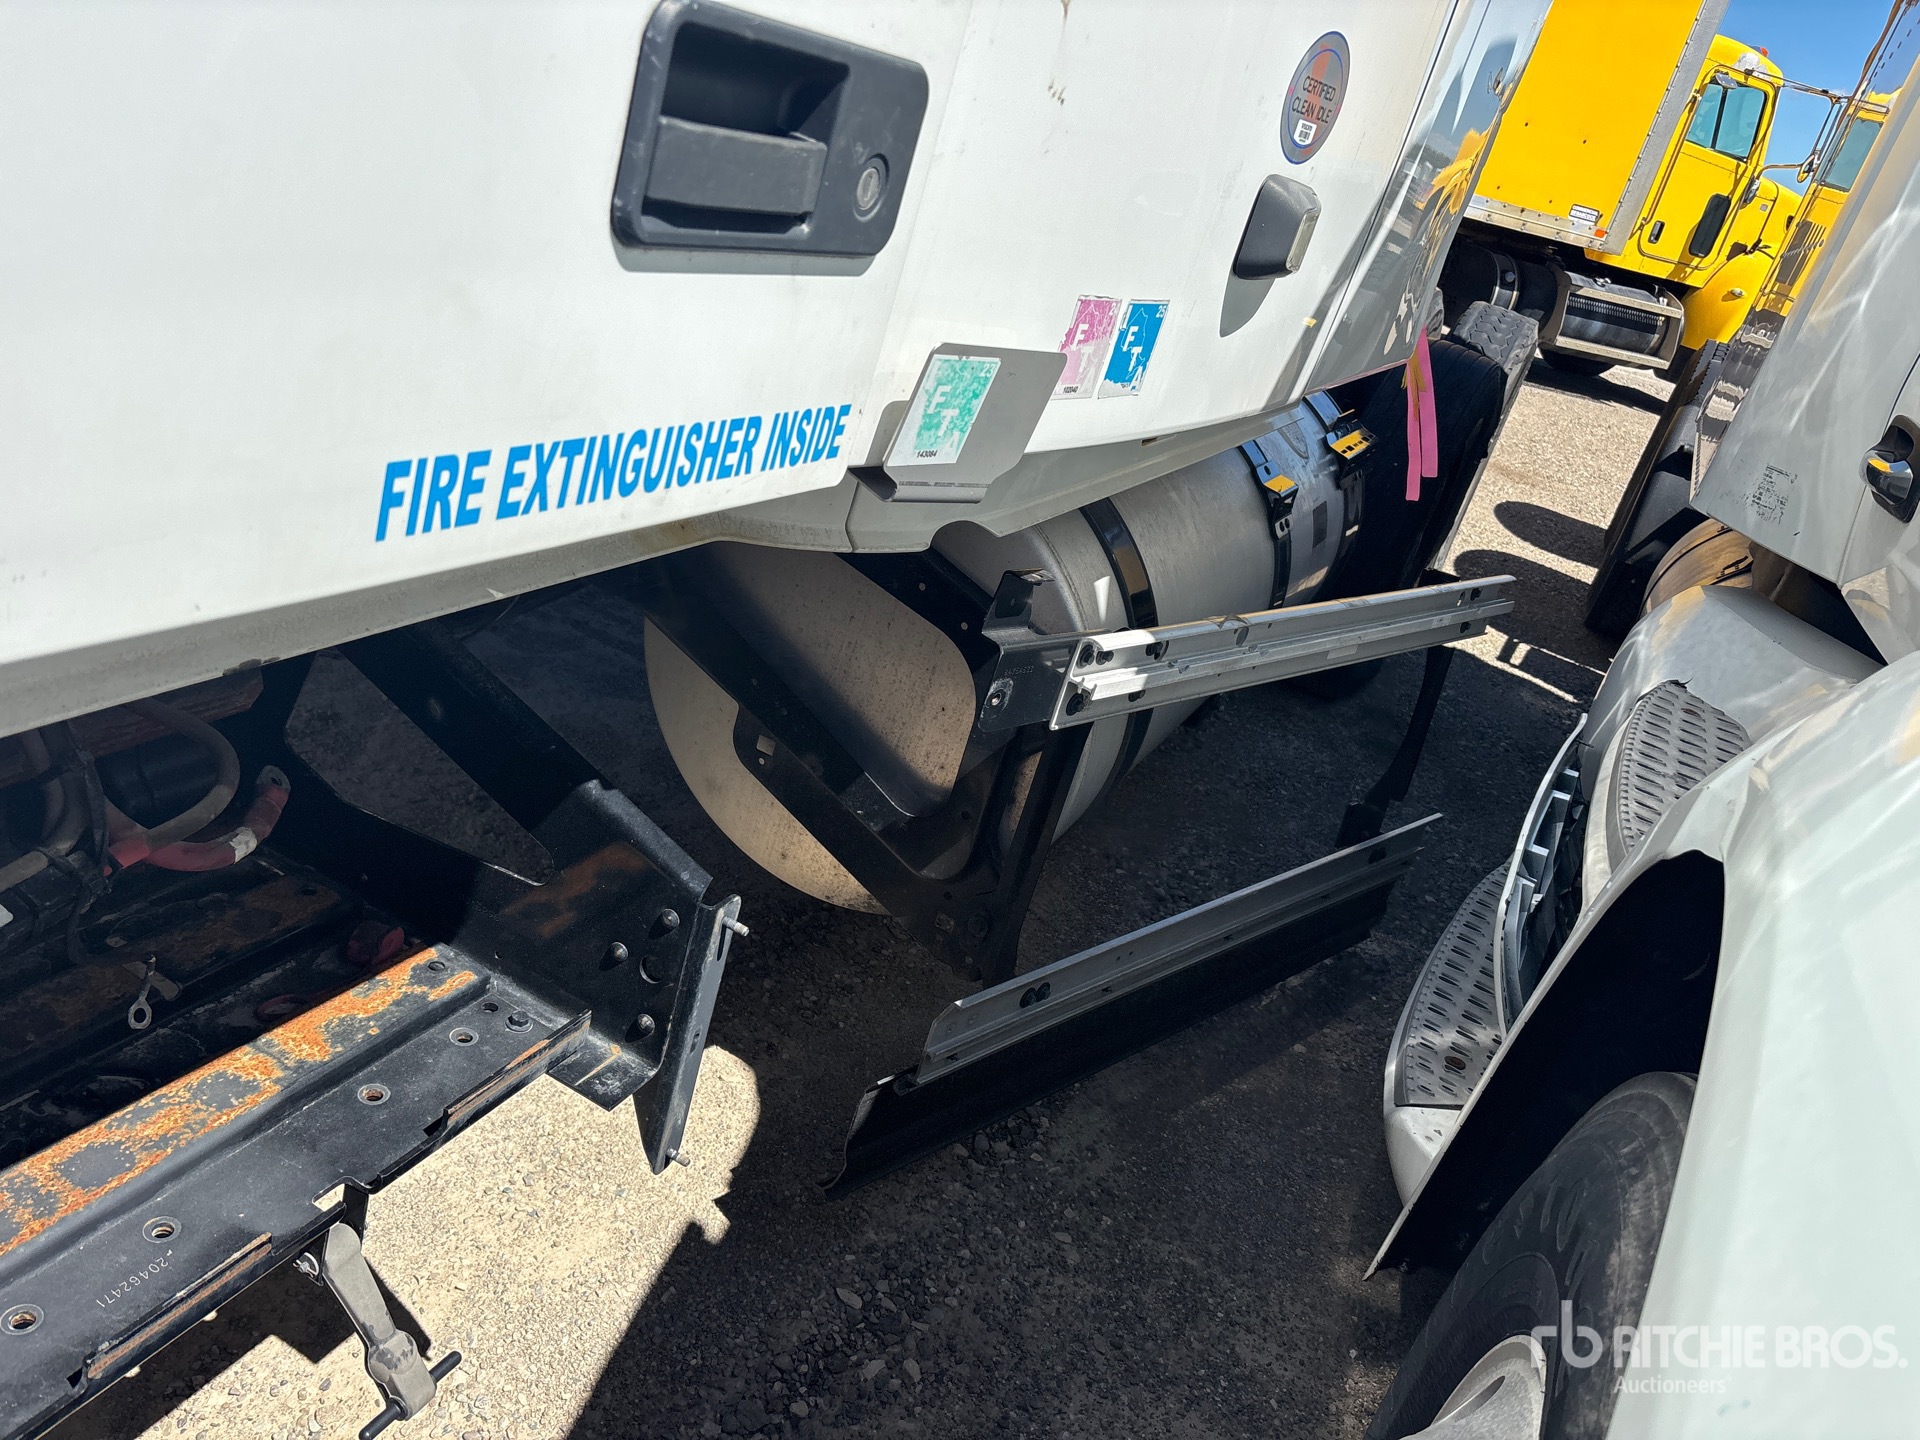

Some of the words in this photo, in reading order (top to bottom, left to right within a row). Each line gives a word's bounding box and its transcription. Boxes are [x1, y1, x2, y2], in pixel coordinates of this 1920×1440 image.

[1302, 76, 1337, 102] CERTIFIED
[1292, 96, 1317, 119] CLEAN
[1316, 105, 1332, 124] IDLE
[1156, 305, 1167, 318] 25
[979, 363, 996, 377] 23
[375, 449, 493, 542] FIRE
[496, 415, 763, 520] EXTINGUISHER
[760, 403, 852, 471] INSIDE
[96, 1257, 169, 1308] 20462471
